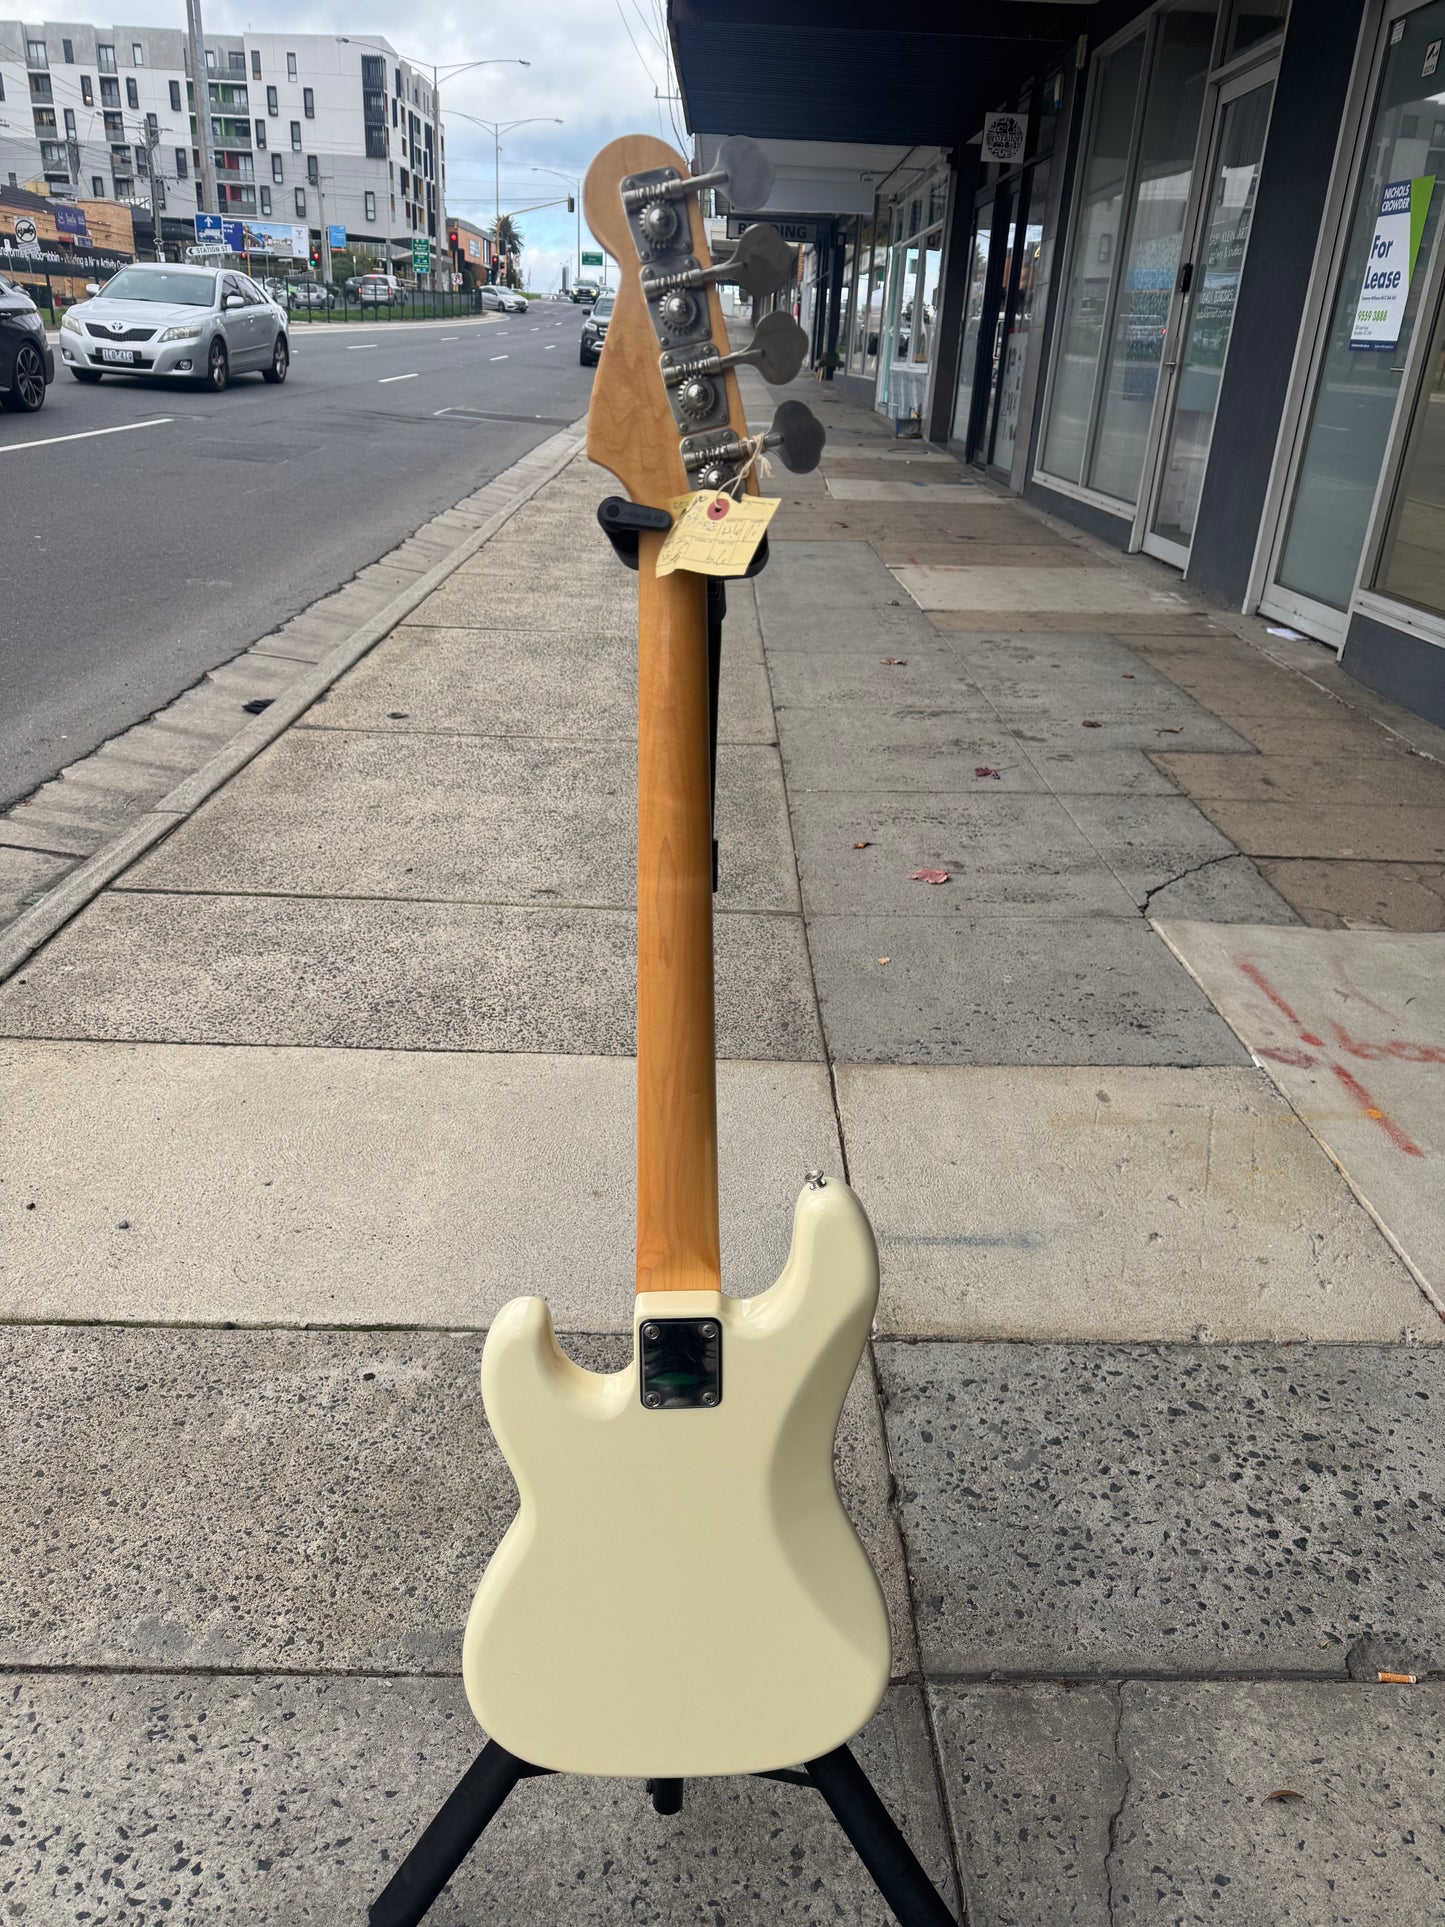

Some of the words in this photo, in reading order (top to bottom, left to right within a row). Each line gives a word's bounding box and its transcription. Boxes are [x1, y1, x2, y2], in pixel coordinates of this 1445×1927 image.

[1383, 184, 1410, 199] NICHOLS
[1381, 197, 1410, 212] CROWDER
[1370, 235, 1393, 259] For
[1364, 266, 1401, 290] Lease
[1357, 311, 1373, 321] 9559
[1373, 310, 1388, 321] 3888
